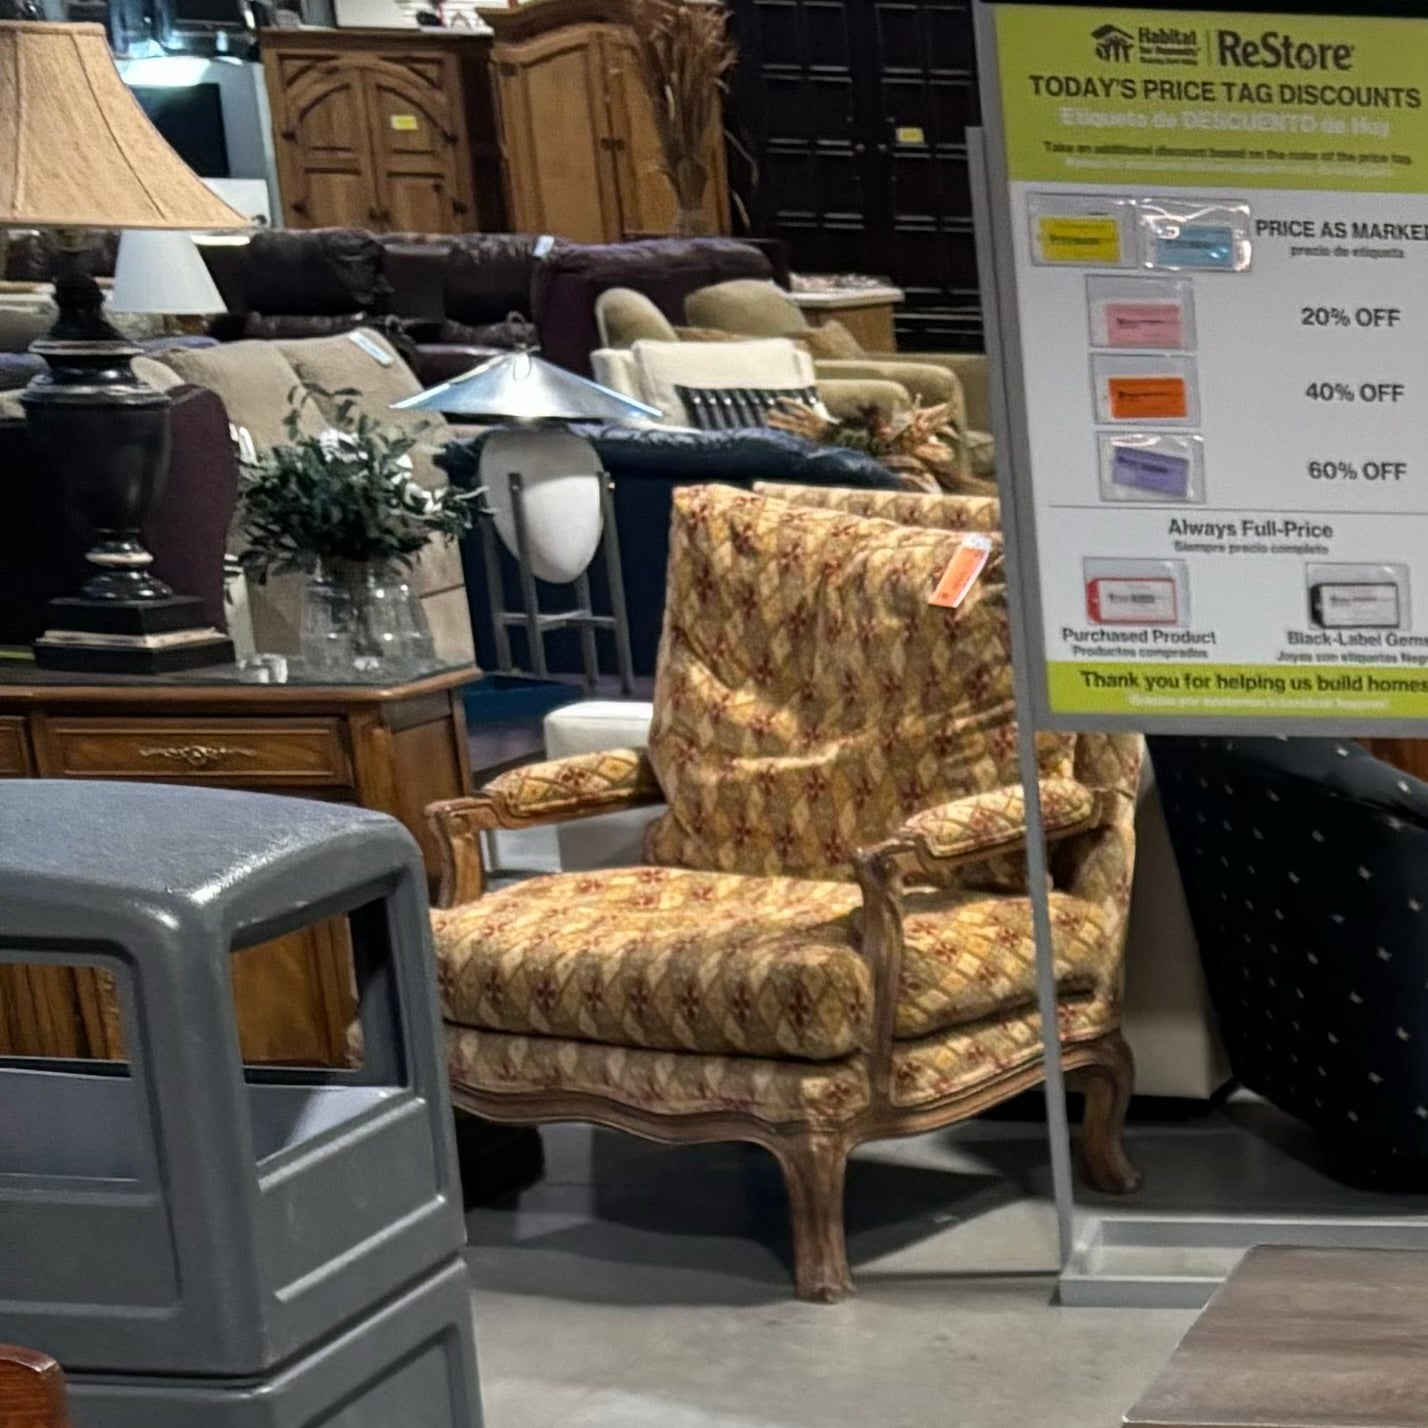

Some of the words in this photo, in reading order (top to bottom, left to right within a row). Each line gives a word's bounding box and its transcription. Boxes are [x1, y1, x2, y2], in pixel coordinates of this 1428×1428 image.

[1138, 27, 1197, 45] Habitat
[1217, 29, 1354, 71] ReStore
[1028, 75, 1137, 100] TODAY'S
[1143, 79, 1217, 101] PRICE
[1222, 82, 1273, 104] TAG
[1279, 84, 1422, 109] DISCOUNTS
[1181, 111, 1318, 133] DESCUENTO
[1255, 219, 1315, 238] PRICE
[1320, 221, 1348, 239] AS
[1301, 307, 1350, 327] 20%
[1355, 307, 1402, 328] OFF
[1305, 382, 1355, 402] 40%
[1359, 383, 1405, 403] OFF
[1308, 461, 1358, 481] 60%
[1362, 461, 1407, 481] OFF
[1168, 518, 1237, 539] Always
[1242, 519, 1333, 539] Full-Price
[1062, 627, 1149, 644] Purchased
[1152, 629, 1217, 645] Product
[1287, 631, 1382, 647] Black-Label
[1080, 669, 1140, 689] Thank
[1144, 674, 1180, 692] you
[1185, 672, 1211, 689] for
[1216, 673, 1286, 693] helping
[1290, 677, 1312, 691] us
[1316, 675, 1363, 692] build
